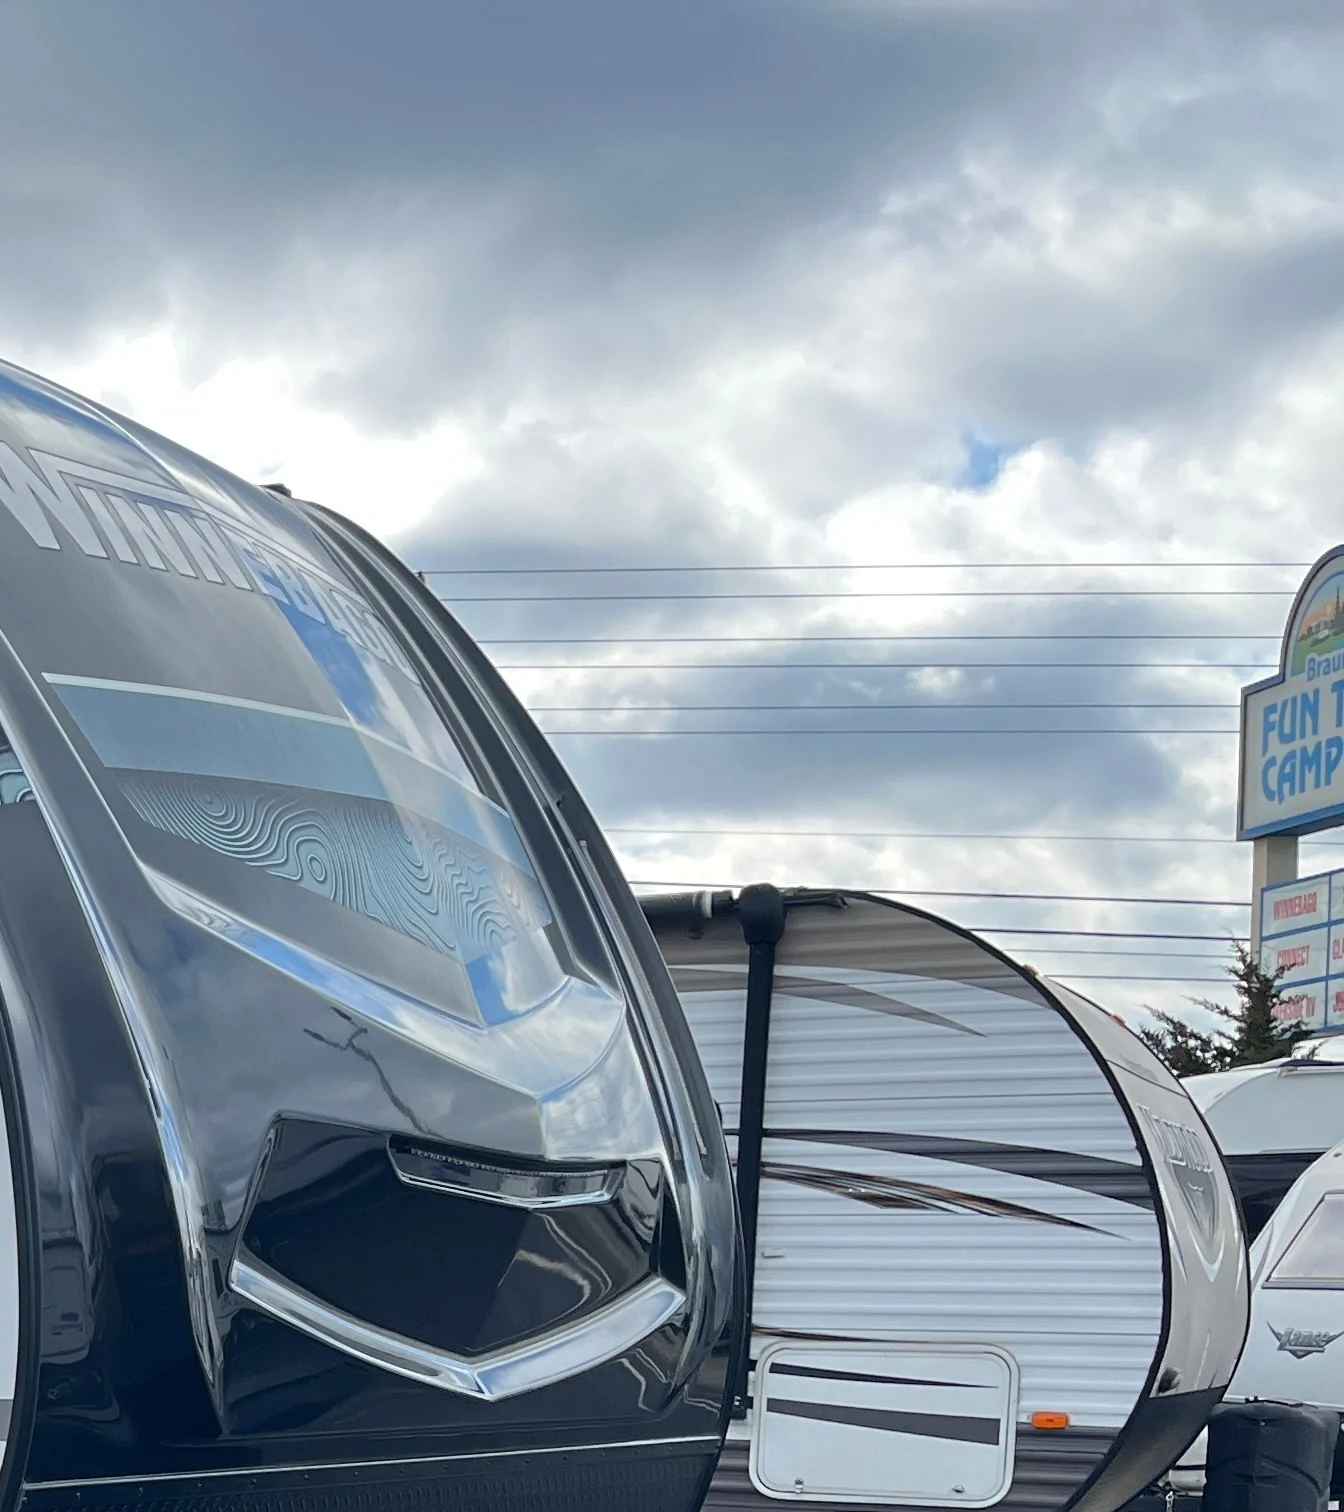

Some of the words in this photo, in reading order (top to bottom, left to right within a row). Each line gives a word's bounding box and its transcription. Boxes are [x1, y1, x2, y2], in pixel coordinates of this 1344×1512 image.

[1307, 653, 1344, 682] Brau
[1262, 688, 1320, 758] FUN
[1274, 892, 1317, 921] WINNEBAGO
